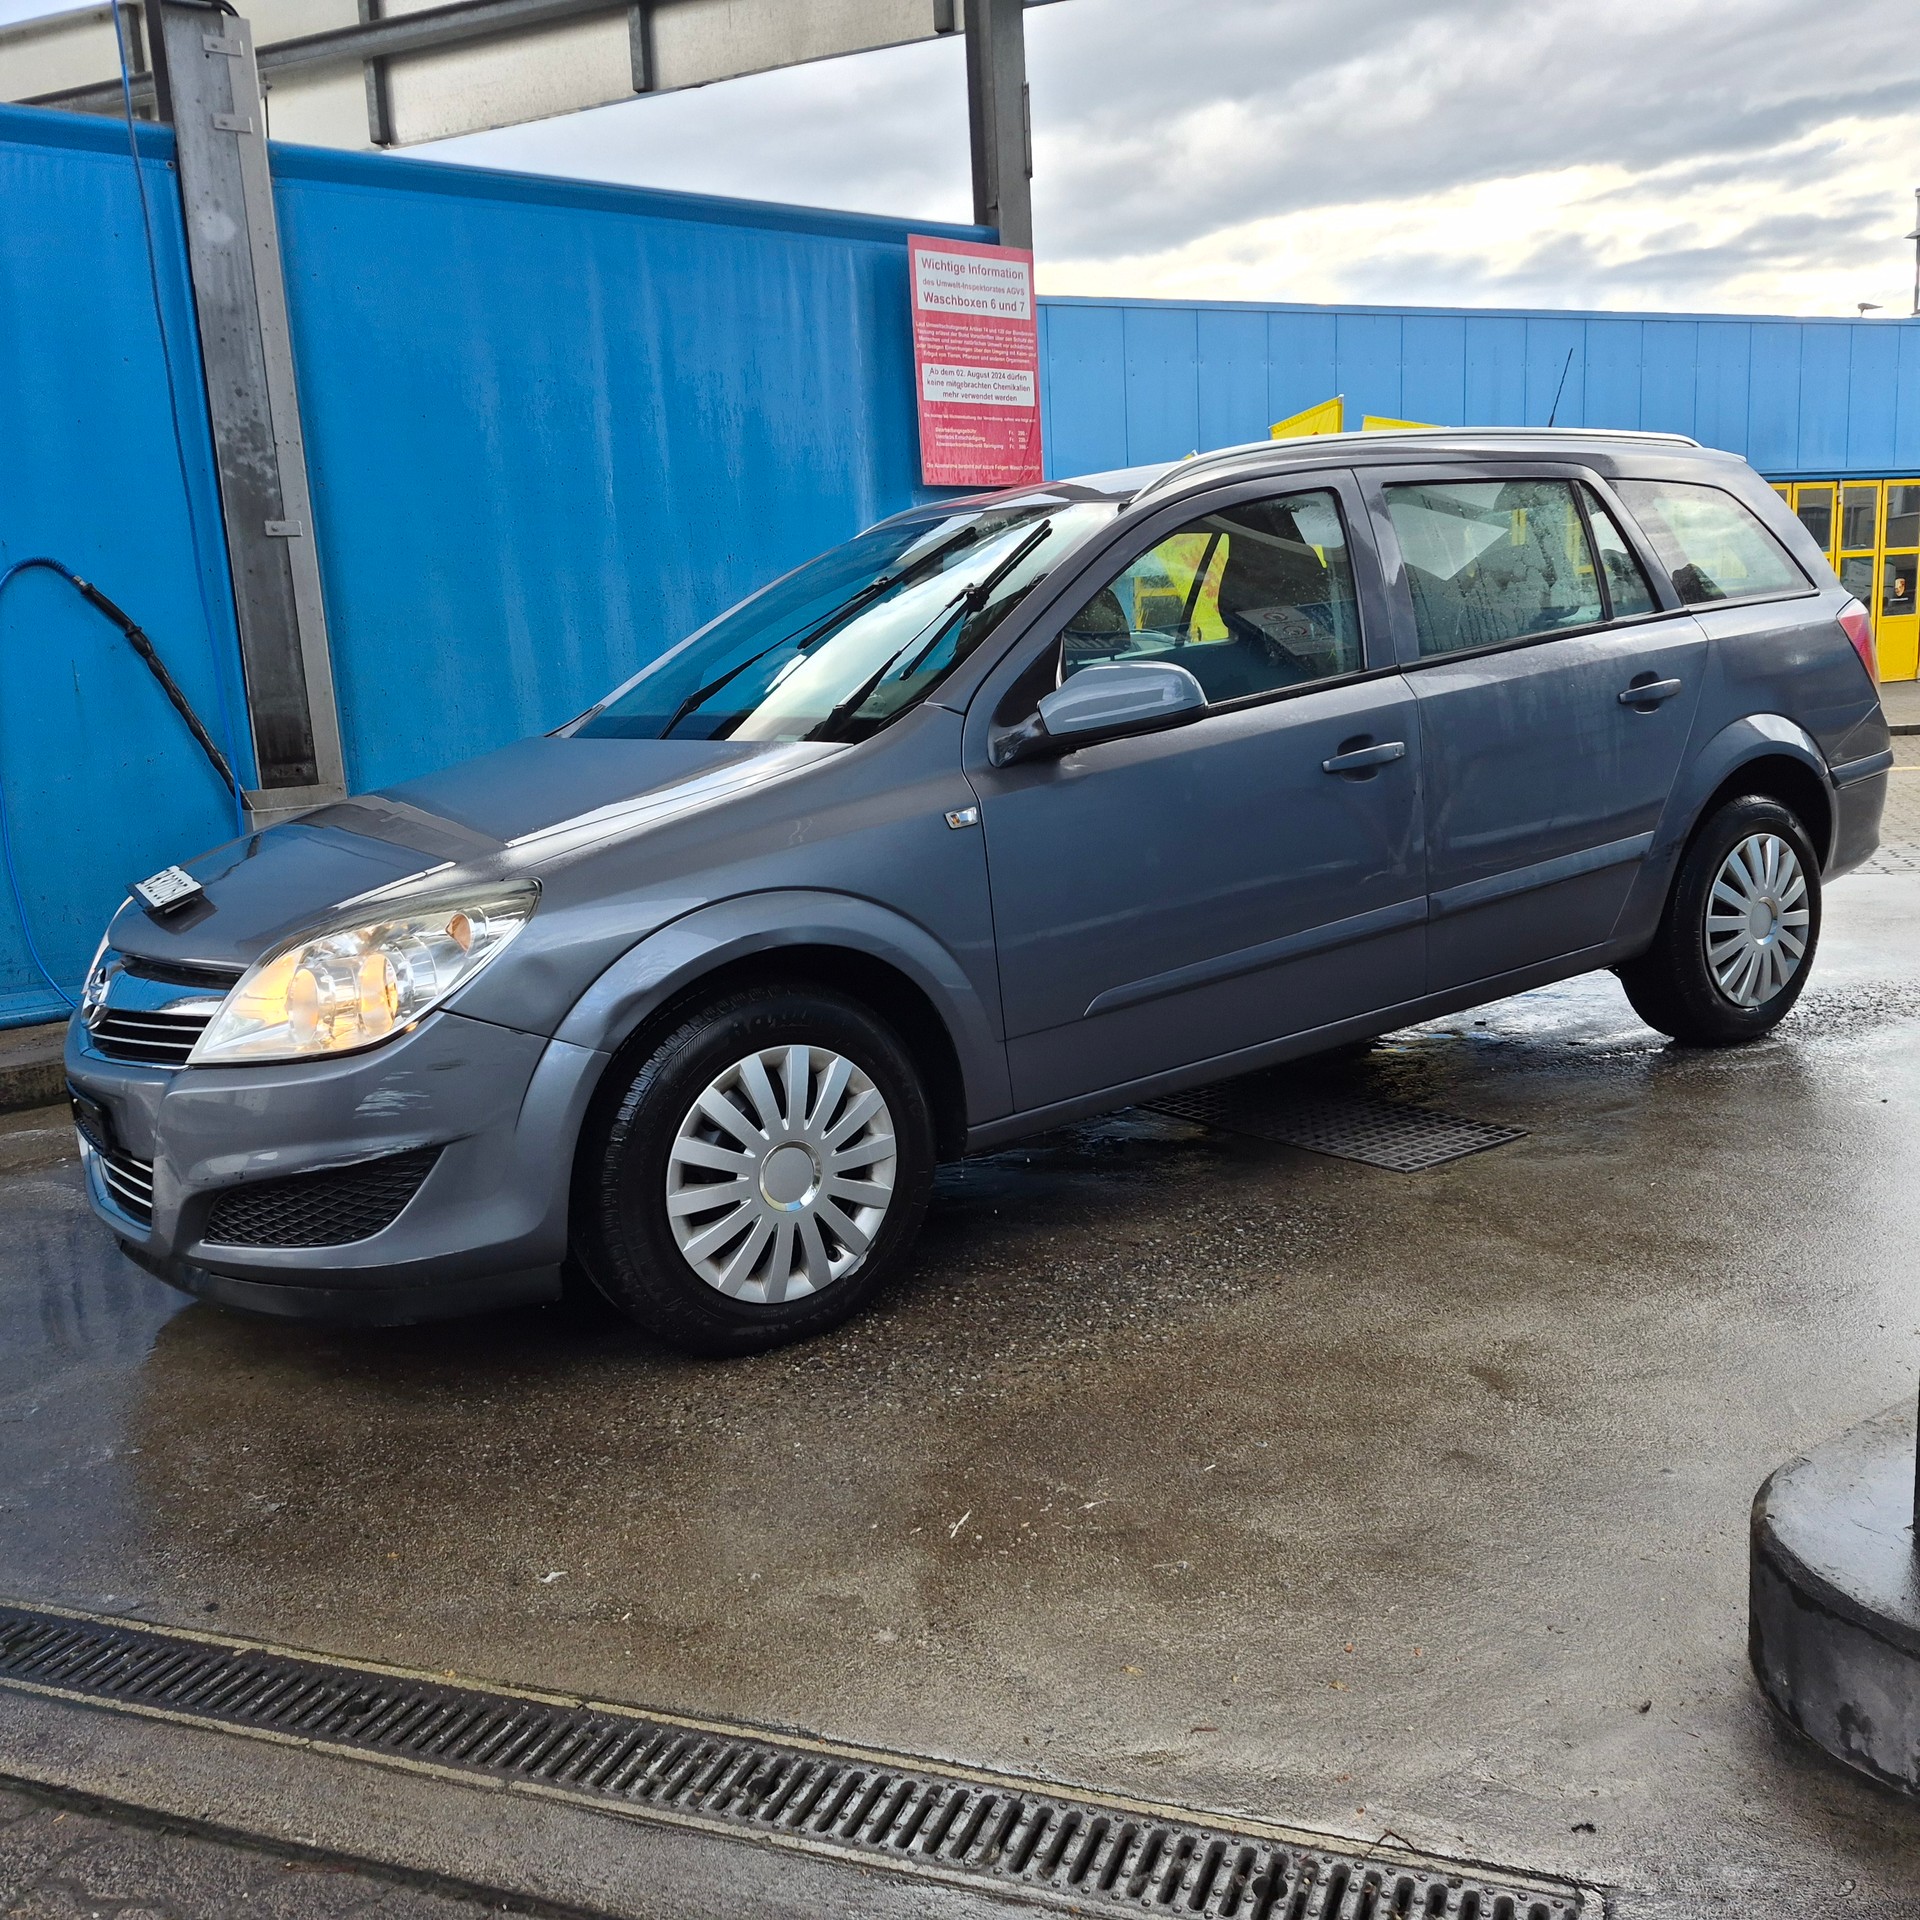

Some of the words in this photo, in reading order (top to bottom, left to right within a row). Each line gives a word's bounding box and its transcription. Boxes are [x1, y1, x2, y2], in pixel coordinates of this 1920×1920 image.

[921, 257, 966, 275] Wichtige
[969, 263, 1024, 280] Information
[922, 278, 935, 286] des
[923, 291, 988, 309] Waschboxen
[990, 299, 997, 309] 6
[999, 301, 1017, 312] und
[1019, 302, 1025, 312] 7
[929, 367, 939, 375] Ab
[940, 368, 955, 376] dem
[967, 370, 990, 379] August
[1007, 372, 1027, 381] dürfen
[926, 378, 945, 386] keine
[946, 380, 992, 390] mitgebrachten
[993, 382, 1031, 392] Chemikalien
